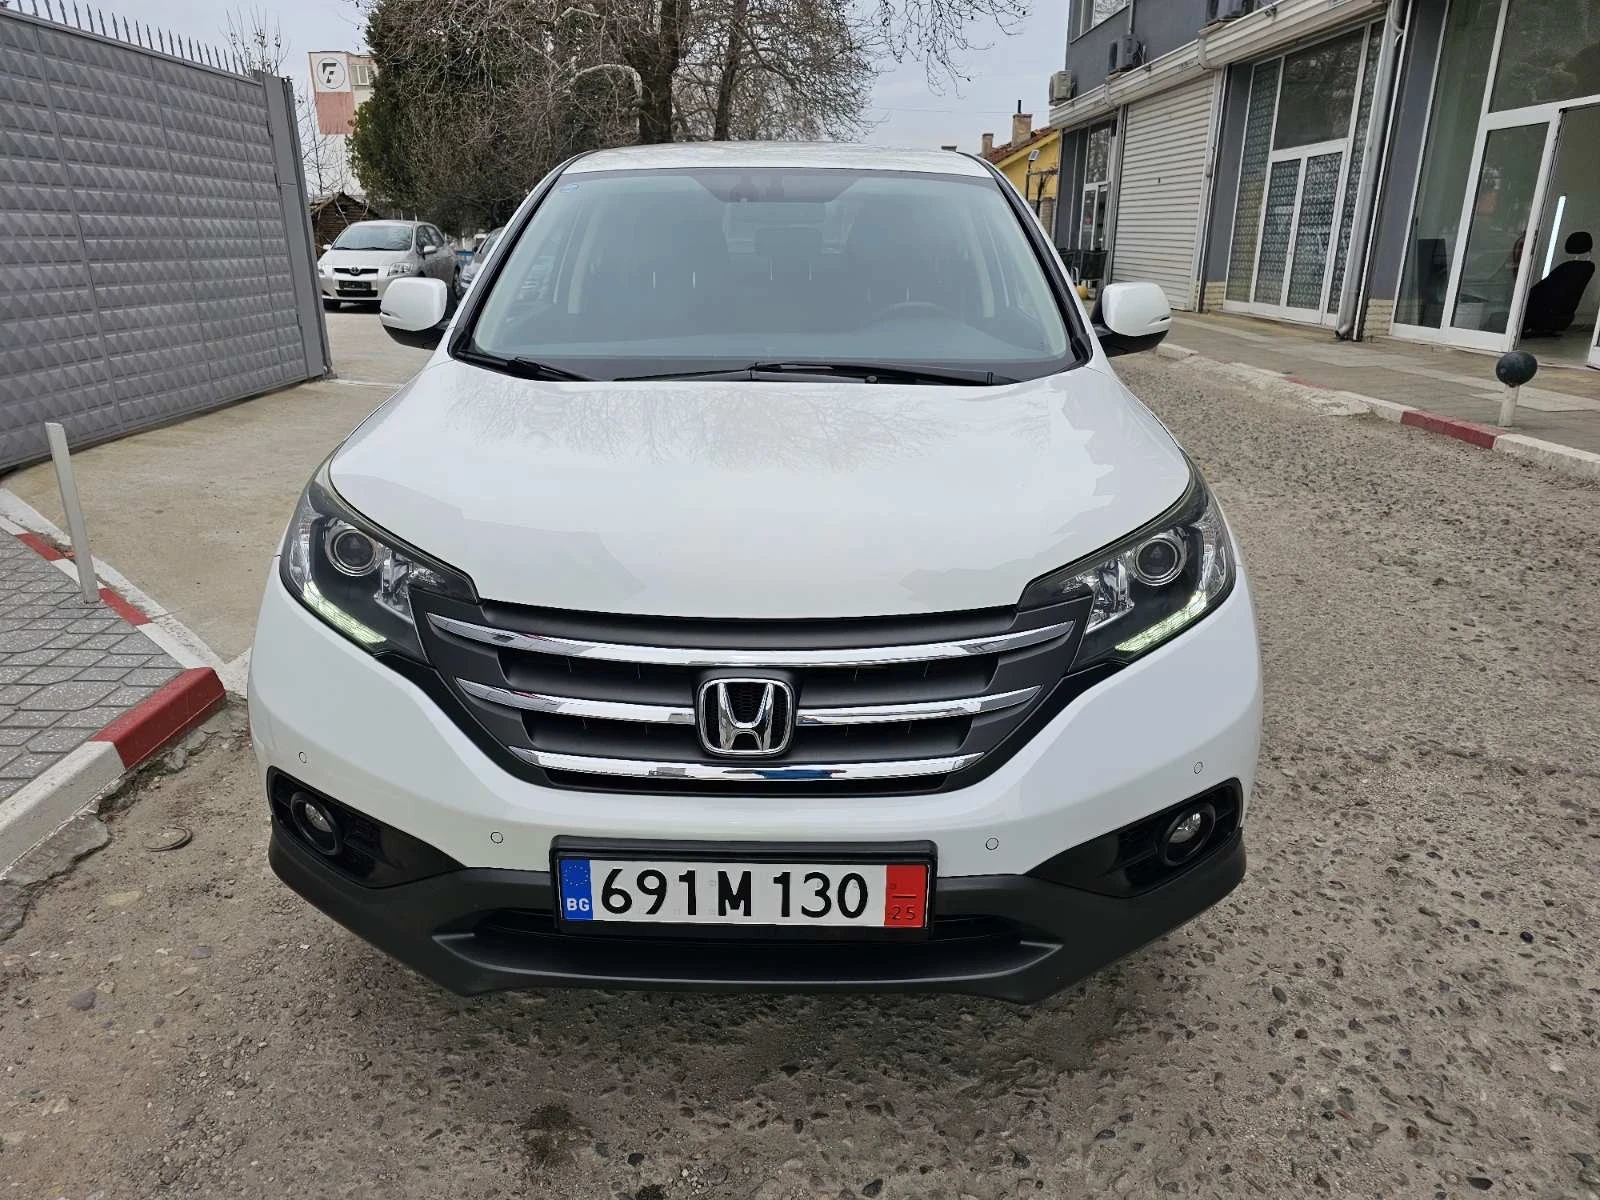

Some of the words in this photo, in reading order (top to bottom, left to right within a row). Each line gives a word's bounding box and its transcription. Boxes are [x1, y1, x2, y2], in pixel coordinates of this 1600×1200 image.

[601, 868, 697, 916] 691
[717, 870, 752, 917] M
[773, 871, 868, 919] 130
[566, 897, 590, 911] BG
[891, 905, 916, 921] 25
